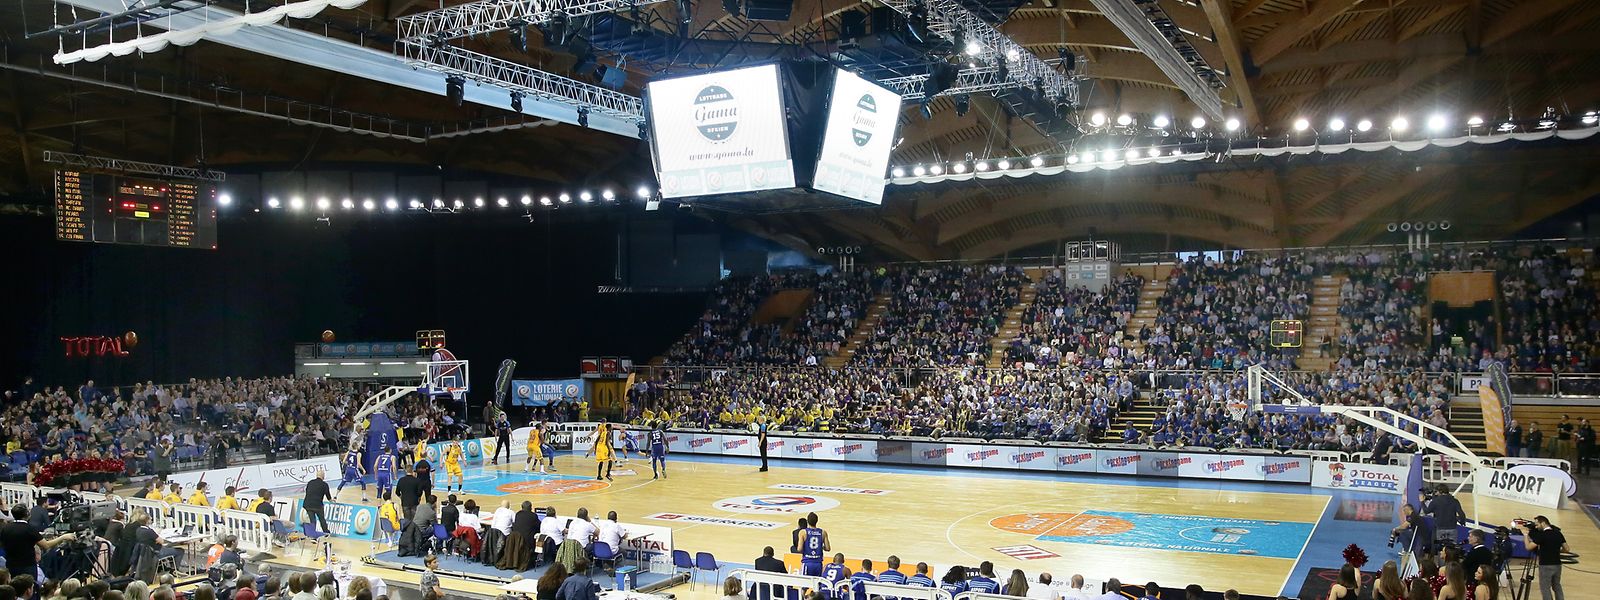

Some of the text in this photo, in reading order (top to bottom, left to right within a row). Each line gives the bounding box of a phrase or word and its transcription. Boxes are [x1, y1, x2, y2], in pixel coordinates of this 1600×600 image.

[695, 106, 737, 123] Gama
[60, 336, 129, 357] TOTAL
[533, 383, 563, 393] LOTERIE
[533, 393, 563, 401] NATIONALE
[550, 434, 571, 444] PORT
[224, 467, 250, 492] FitLine
[1360, 470, 1399, 481] TOTAL
[1355, 480, 1393, 488] LEAGUE
[1489, 470, 1545, 495] ASPORT
[721, 502, 796, 512] TOTAL
[324, 504, 353, 522] OTERIE
[809, 536, 818, 549] 8
[1167, 544, 1231, 553] NATIONALE
[826, 569, 837, 581] 9
